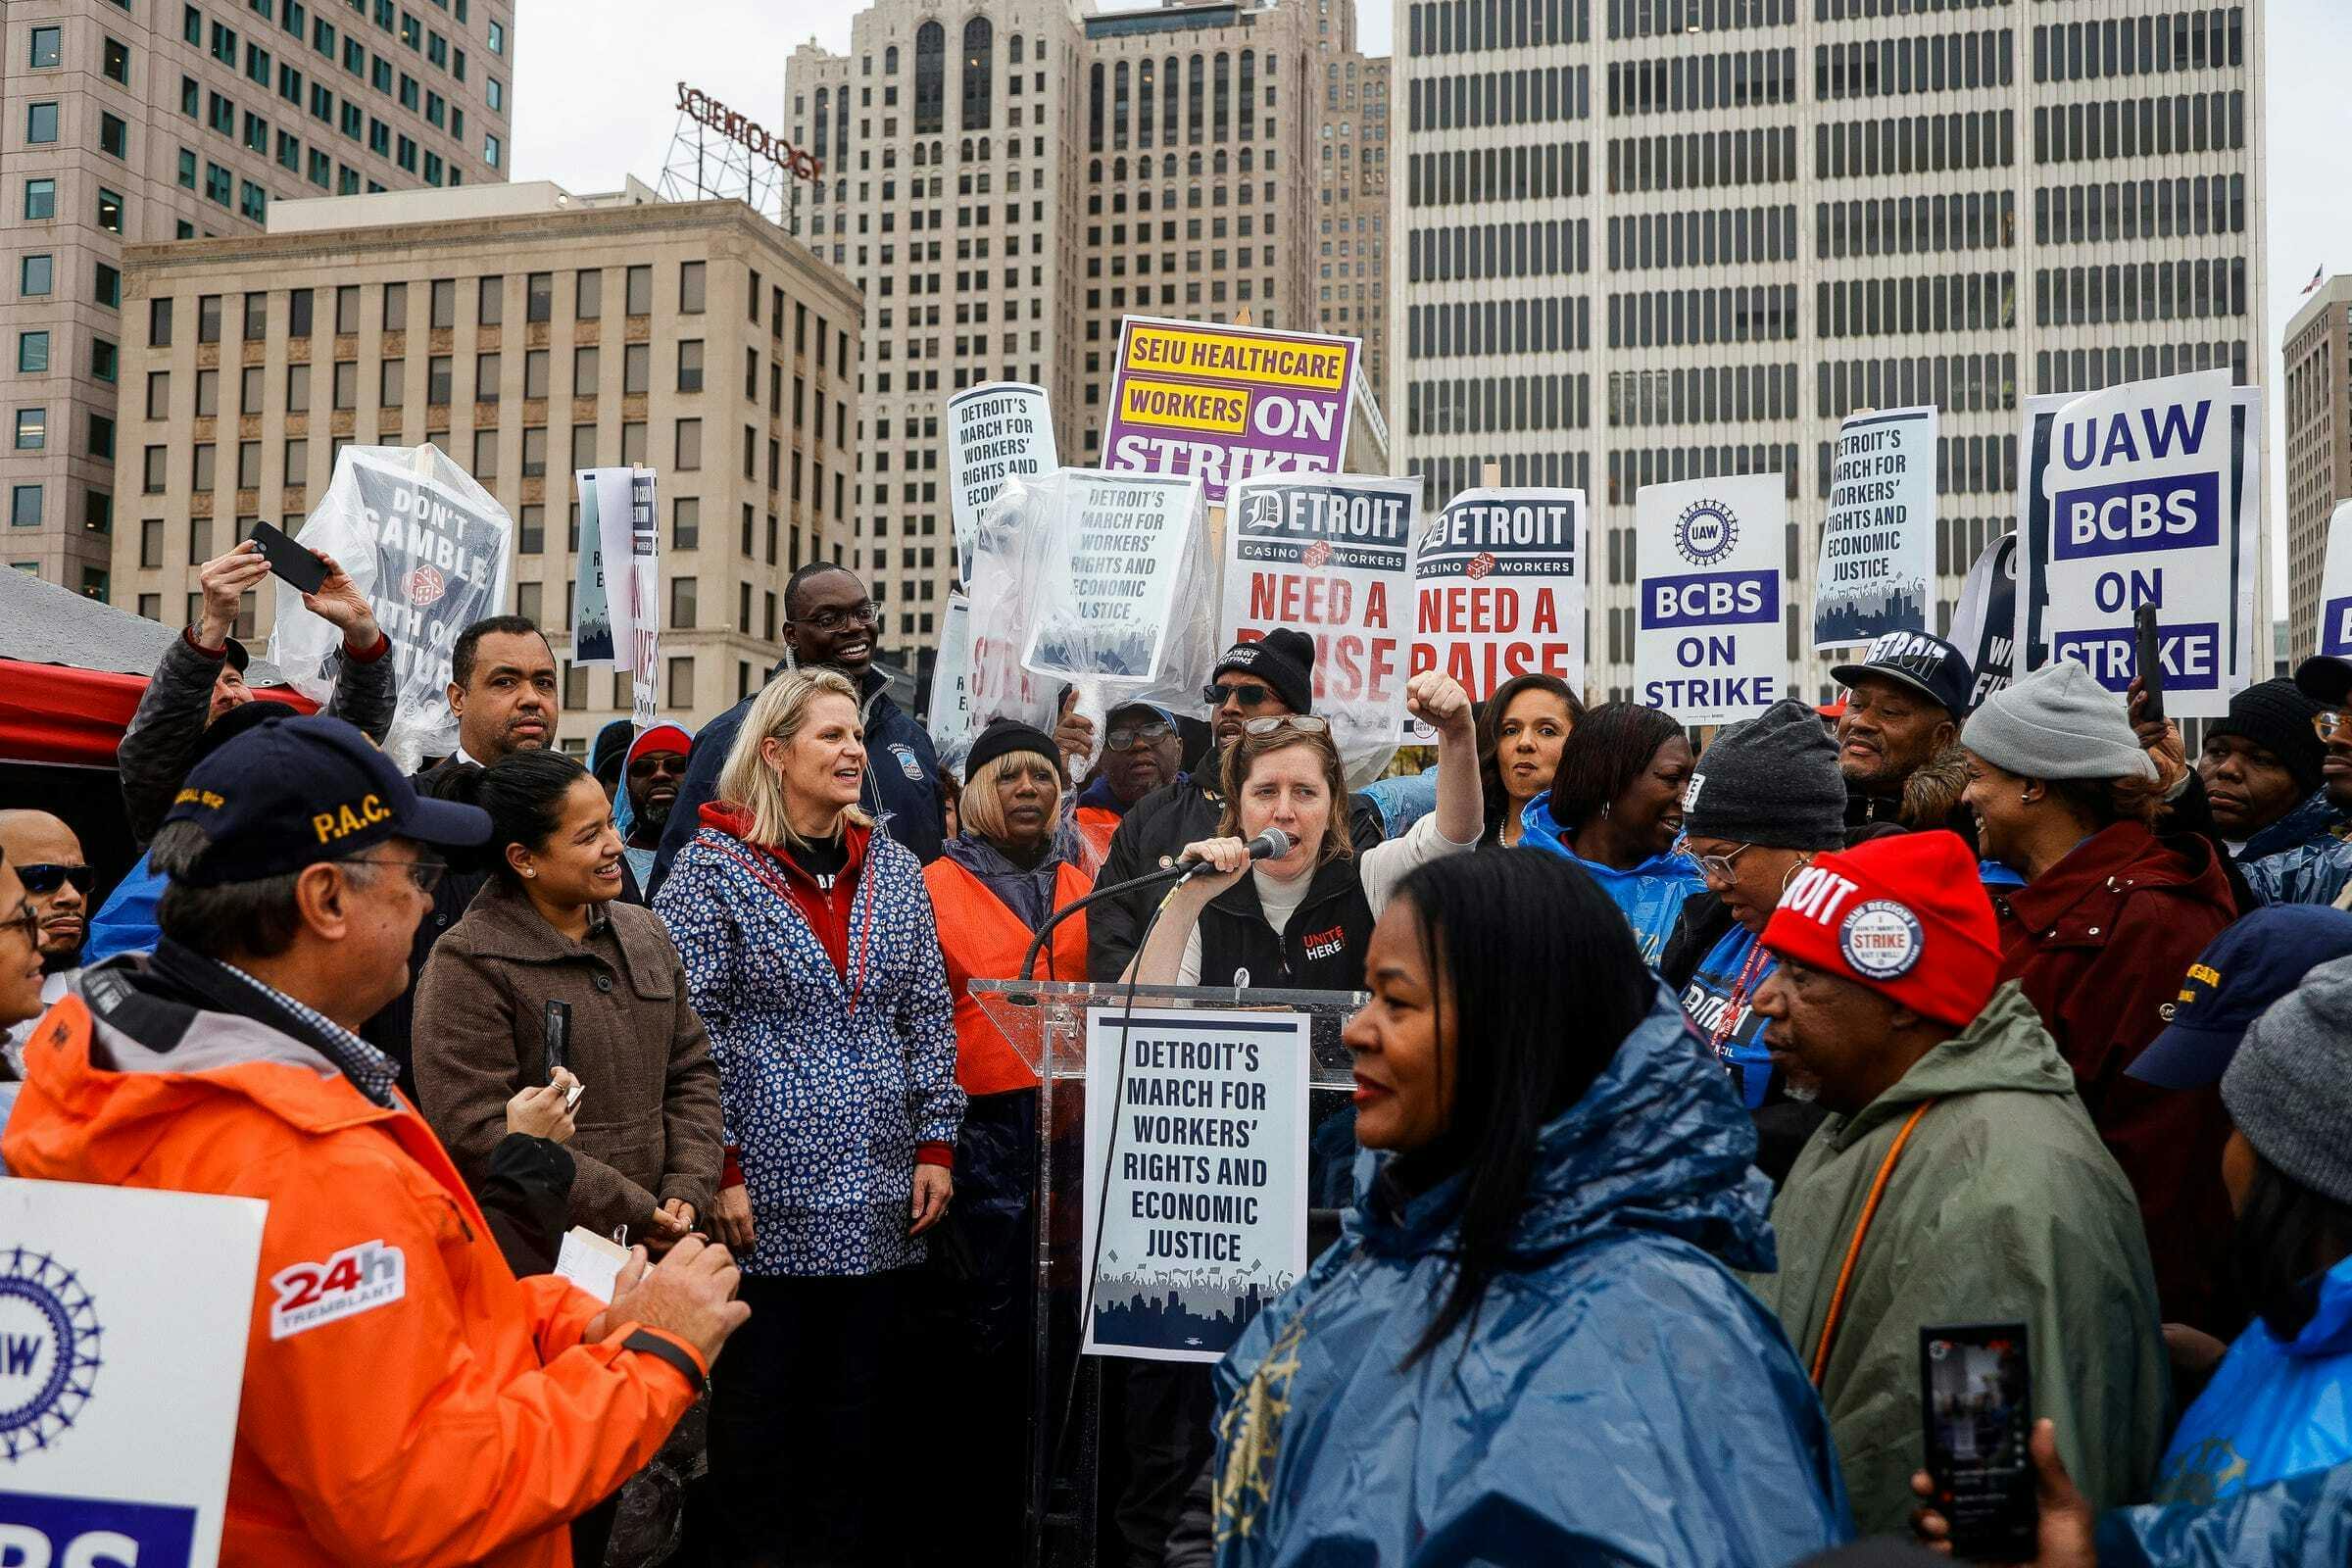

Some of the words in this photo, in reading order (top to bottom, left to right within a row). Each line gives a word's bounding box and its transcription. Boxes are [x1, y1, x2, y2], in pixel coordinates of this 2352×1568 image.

[676, 81, 823, 183] SCIENTOLOGY
[1133, 336, 1187, 365] SEIU
[1191, 342, 1342, 380] HEALTHCARE
[961, 398, 1027, 423] DETROIT'S
[1130, 389, 1244, 423] WORKERS
[1253, 395, 1339, 441] ON
[960, 420, 1002, 446] MARCH
[1006, 418, 1033, 434] FOR
[2063, 399, 2212, 471] UAW
[964, 438, 1030, 465] WORKERS'
[1876, 455, 1906, 475] FOR
[962, 462, 1004, 487] RIGHTS
[1008, 459, 1038, 474] AND
[1089, 489, 1165, 509] DETROIT'S
[1832, 479, 1901, 509] WORKERS'
[394, 486, 468, 539] DON'T
[1082, 512, 1134, 529] MARCH
[1135, 513, 1165, 530] FOR
[1241, 488, 1403, 539] DETROIT
[1827, 510, 1871, 535] RIGHTS
[1874, 506, 1907, 526] AND
[2071, 489, 2198, 546] BCBS
[1082, 534, 1155, 552] WORKERS'
[1418, 507, 1567, 554] DETROIT
[1691, 524, 1719, 540] UAW
[1828, 530, 1900, 558] ECONOMIC
[364, 507, 488, 589] GAMBLE
[1244, 545, 1298, 559] CASINO
[1334, 551, 1402, 566] WORKERS
[1071, 556, 1122, 574] RIGHTS
[1124, 557, 1156, 574] AND
[1416, 562, 1462, 576] CASINO
[1499, 562, 1570, 573] WORKERS
[1833, 558, 1889, 582] JUSTICE
[1250, 572, 1352, 625] NEED
[1363, 581, 1389, 628] A
[1656, 580, 1762, 619] BCBS
[2095, 568, 2163, 613] ON
[1418, 588, 1519, 634] NEED
[1532, 588, 1558, 634] A
[1236, 627, 1396, 703] ISE
[1677, 635, 1737, 667] ON
[1862, 631, 1949, 681] DETROIT
[2060, 635, 2211, 679] STRKE
[1645, 676, 1775, 709] STRIKE
[314, 794, 391, 844] P.A.C.
[1303, 925, 1344, 948] UNITE
[1854, 934, 1905, 949] STRIKE
[1135, 1040, 1259, 1072] DETROIT'S
[1127, 1079, 1213, 1109] MARCH
[1221, 1081, 1266, 1110] FOR
[1133, 1115, 1258, 1149] WORKERS'
[1123, 1152, 1210, 1184] RIGHTS
[1217, 1157, 1267, 1188] AND
[1131, 1191, 1258, 1225] ECONOMIC
[1146, 1229, 1242, 1262] JUSTICE
[281, 1250, 396, 1312] 24h
[282, 1282, 396, 1328] TREMBLANT
